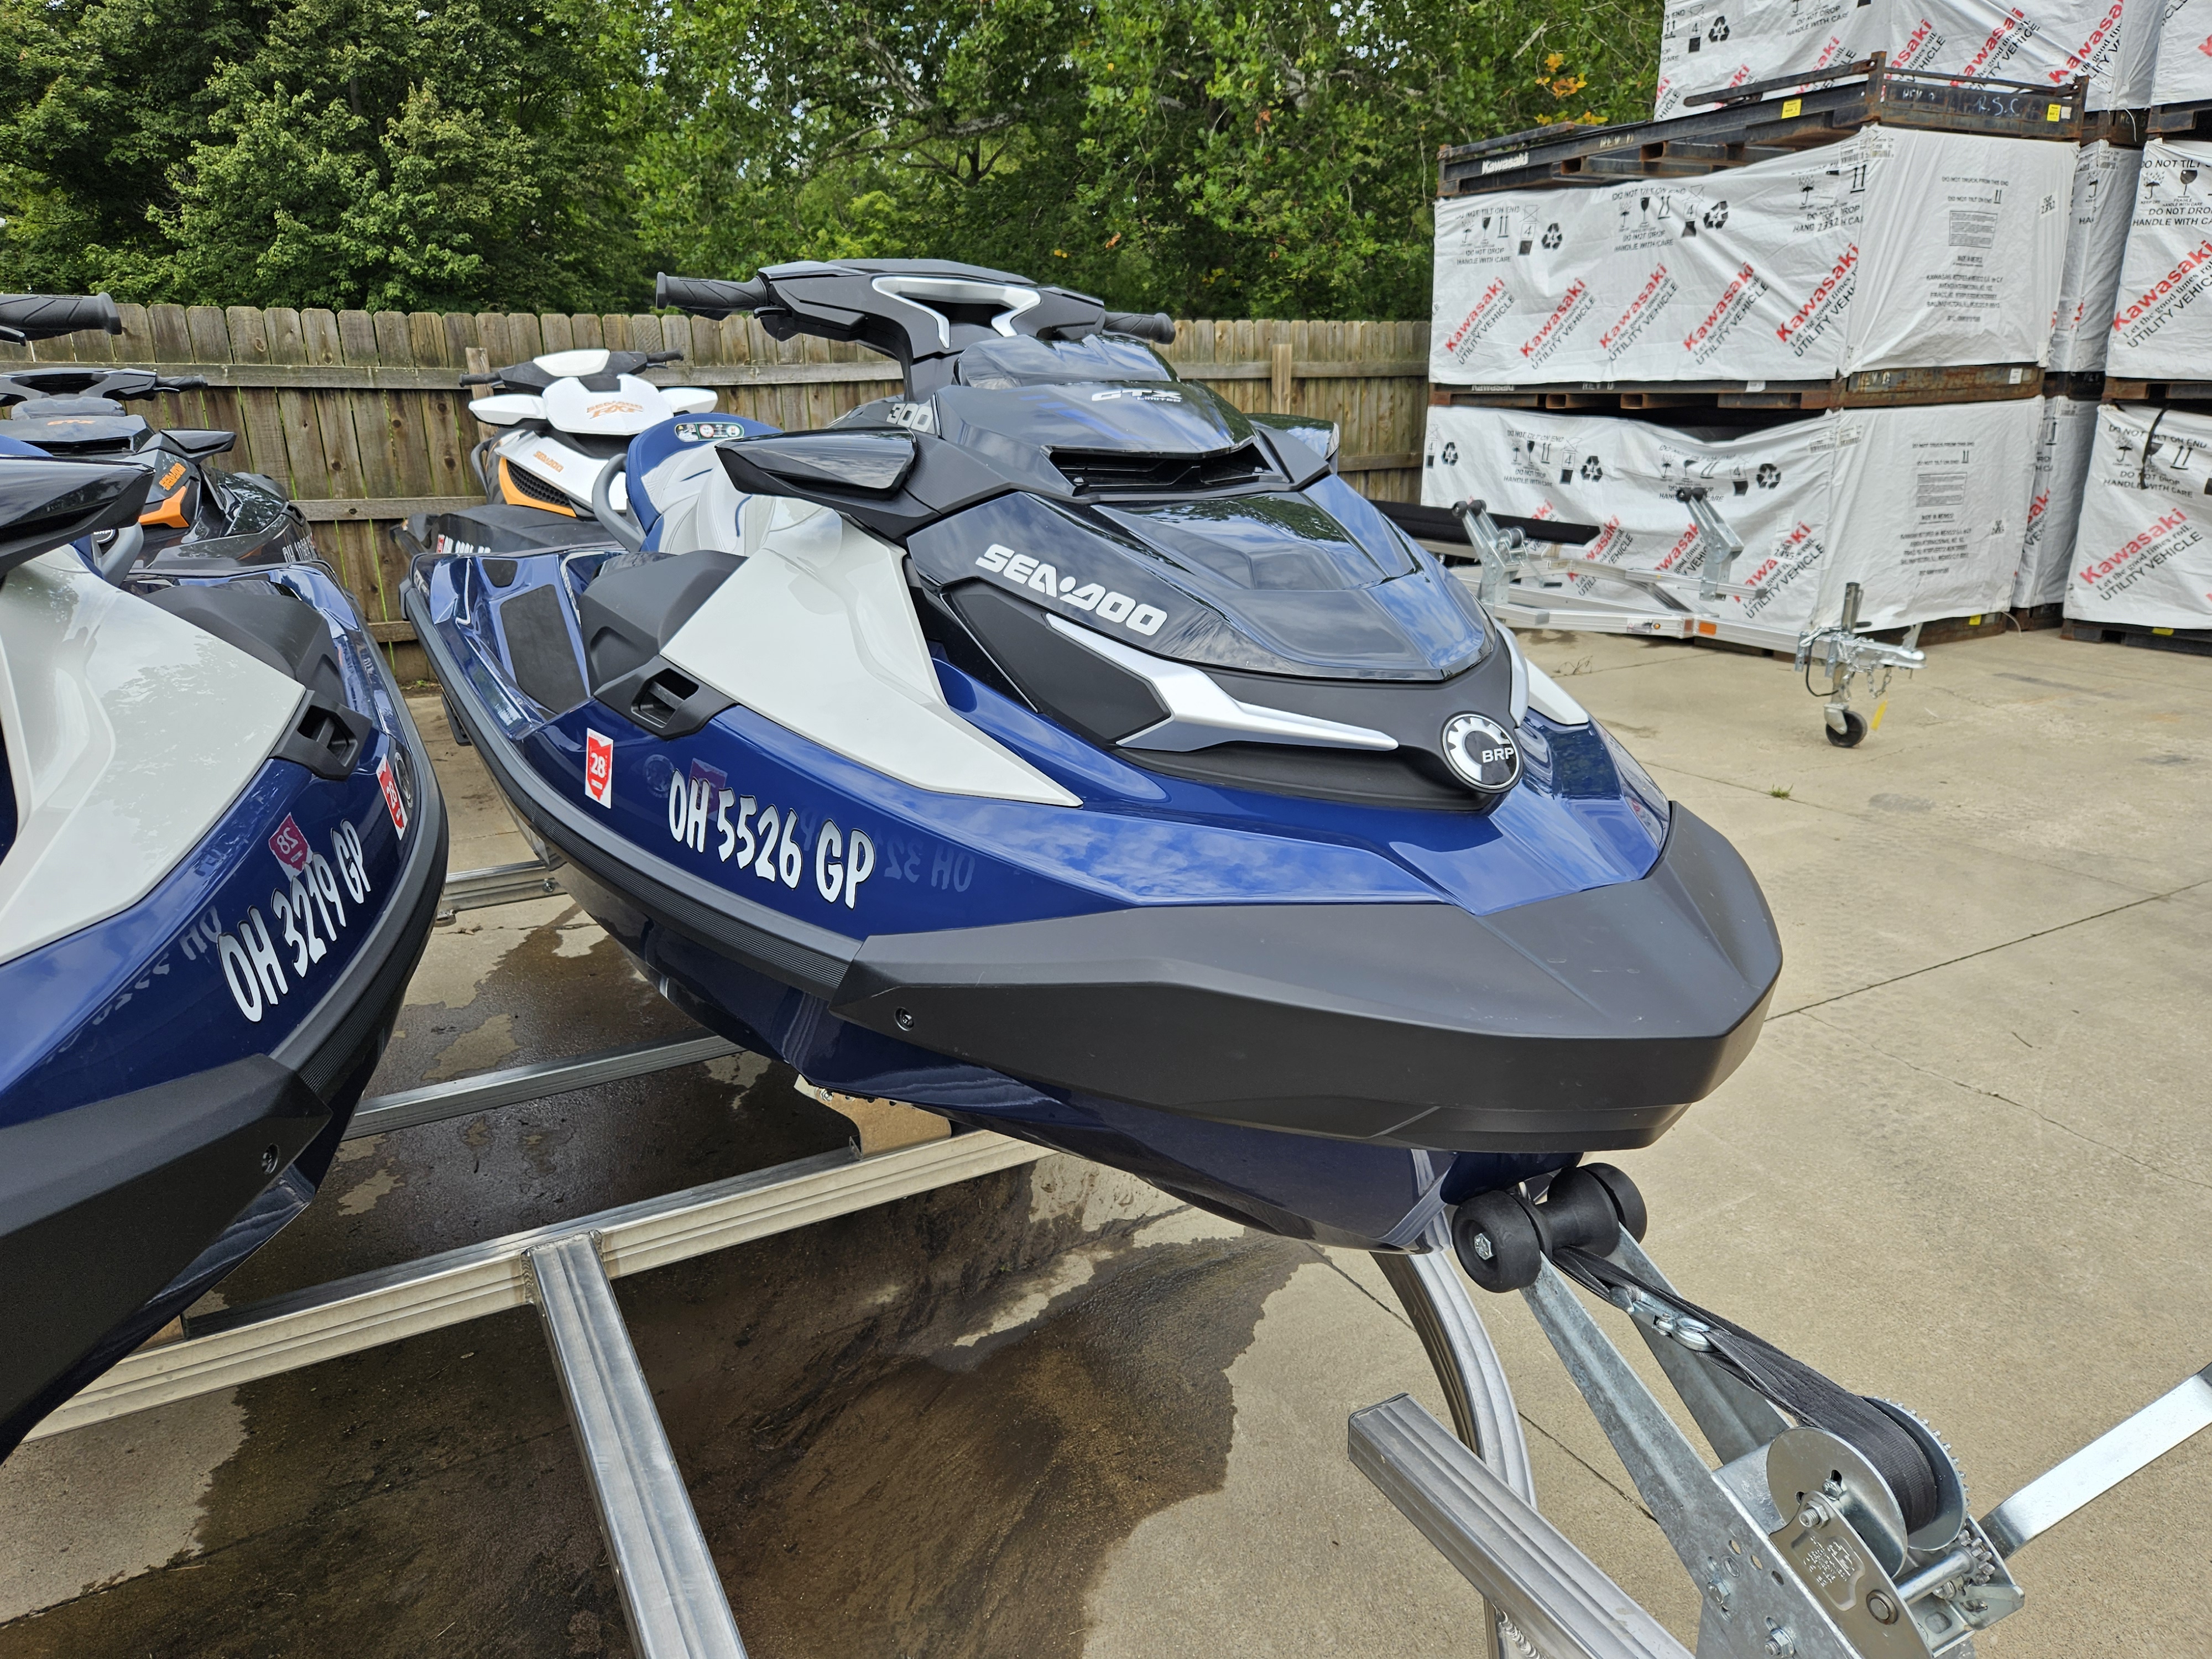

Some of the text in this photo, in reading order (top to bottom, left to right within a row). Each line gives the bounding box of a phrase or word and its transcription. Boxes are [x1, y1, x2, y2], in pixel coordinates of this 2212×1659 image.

[1481, 151, 1529, 175] Kawasaki
[2155, 160, 2178, 168] NOT
[2132, 218, 2172, 226] HANDLE
[1445, 276, 1505, 353] Kawasaki
[1519, 278, 1587, 358] Kawasaki
[1598, 261, 1668, 349] Kawasaki
[1609, 280, 1679, 361] UTILITY VEHICLE
[1682, 260, 1755, 351] Kawasaki
[1776, 242, 1860, 343] Kawasaki
[2112, 239, 2212, 332] Kawasaki
[2127, 275, 2212, 348] UTILITY VEHIC
[2155, 293, 2177, 314] good
[2176, 273, 2199, 294] times
[1458, 294, 1515, 365] UTILITY VEHICLE
[1532, 295, 1597, 370] UTILITY VEHICLE
[1695, 281, 1769, 366] UTILITY VEHICLE
[1794, 315, 1832, 358] UTILITY
[886, 403, 934, 433] 300
[1091, 388, 1183, 401] GTX
[2124, 427, 2148, 437] NOT
[2171, 435, 2184, 444] ON
[2187, 439, 2207, 448] END
[1504, 476, 1528, 484] HANDLE
[2104, 479, 2193, 498] HANDLE WITH CARE
[2159, 476, 2180, 486] DROP
[1746, 583, 1781, 619] UTILITY
[1780, 544, 1825, 585] VEHICLE
[2079, 508, 2188, 585] Kawasaki
[2100, 531, 2203, 601] UTILITY VEHICLE
[2128, 554, 2147, 571] good
[2147, 539, 2171, 555] times
[591, 752, 606, 779] 28
[1481, 747, 1515, 764] BRP
[386, 780, 397, 810] 28
[668, 768, 876, 910] OH 5526 GP
[217, 818, 372, 1023] OH 3219 GP
